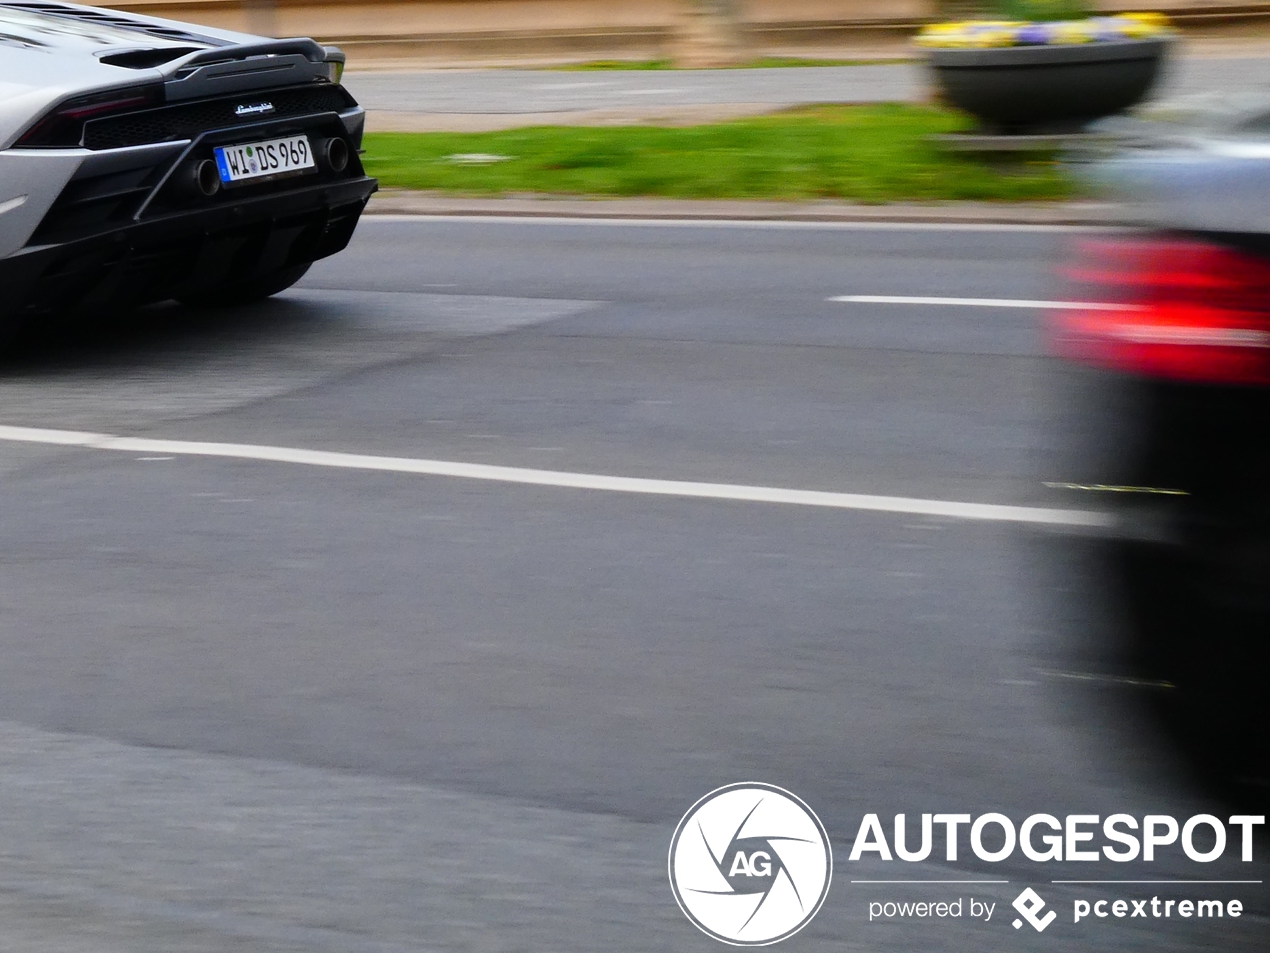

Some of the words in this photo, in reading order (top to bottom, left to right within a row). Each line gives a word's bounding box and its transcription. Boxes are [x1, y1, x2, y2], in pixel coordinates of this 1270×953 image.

[226, 149, 250, 176] WI
[254, 144, 279, 171] DS
[279, 139, 307, 167] 969
